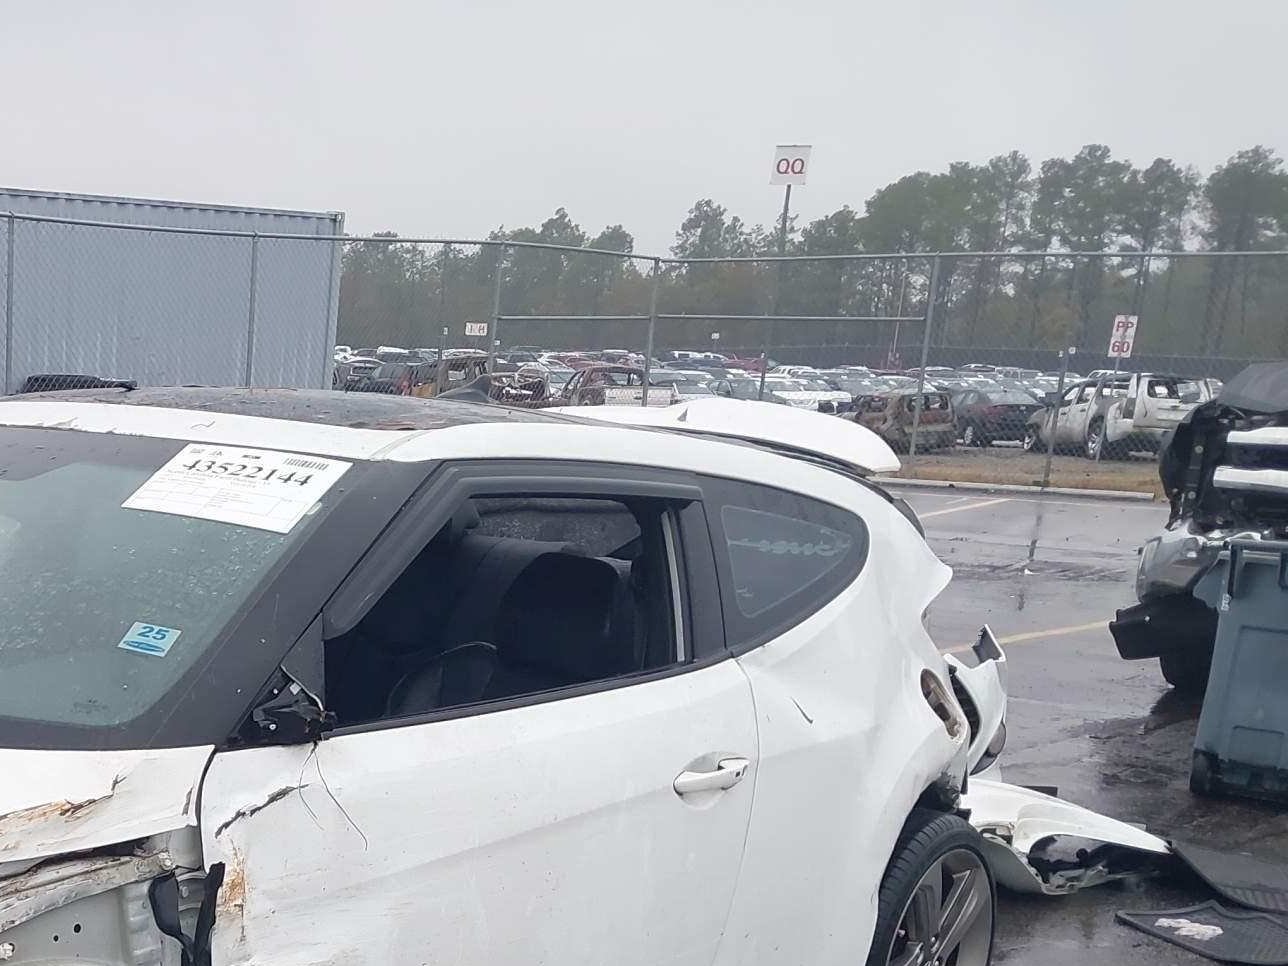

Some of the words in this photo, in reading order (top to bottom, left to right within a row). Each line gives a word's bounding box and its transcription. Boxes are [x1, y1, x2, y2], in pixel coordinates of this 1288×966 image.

[776, 157, 805, 175] QQ
[1115, 320, 1135, 333] PP
[1112, 340, 1130, 353] 60
[183, 458, 313, 487] 43522144
[137, 625, 169, 641] 25
